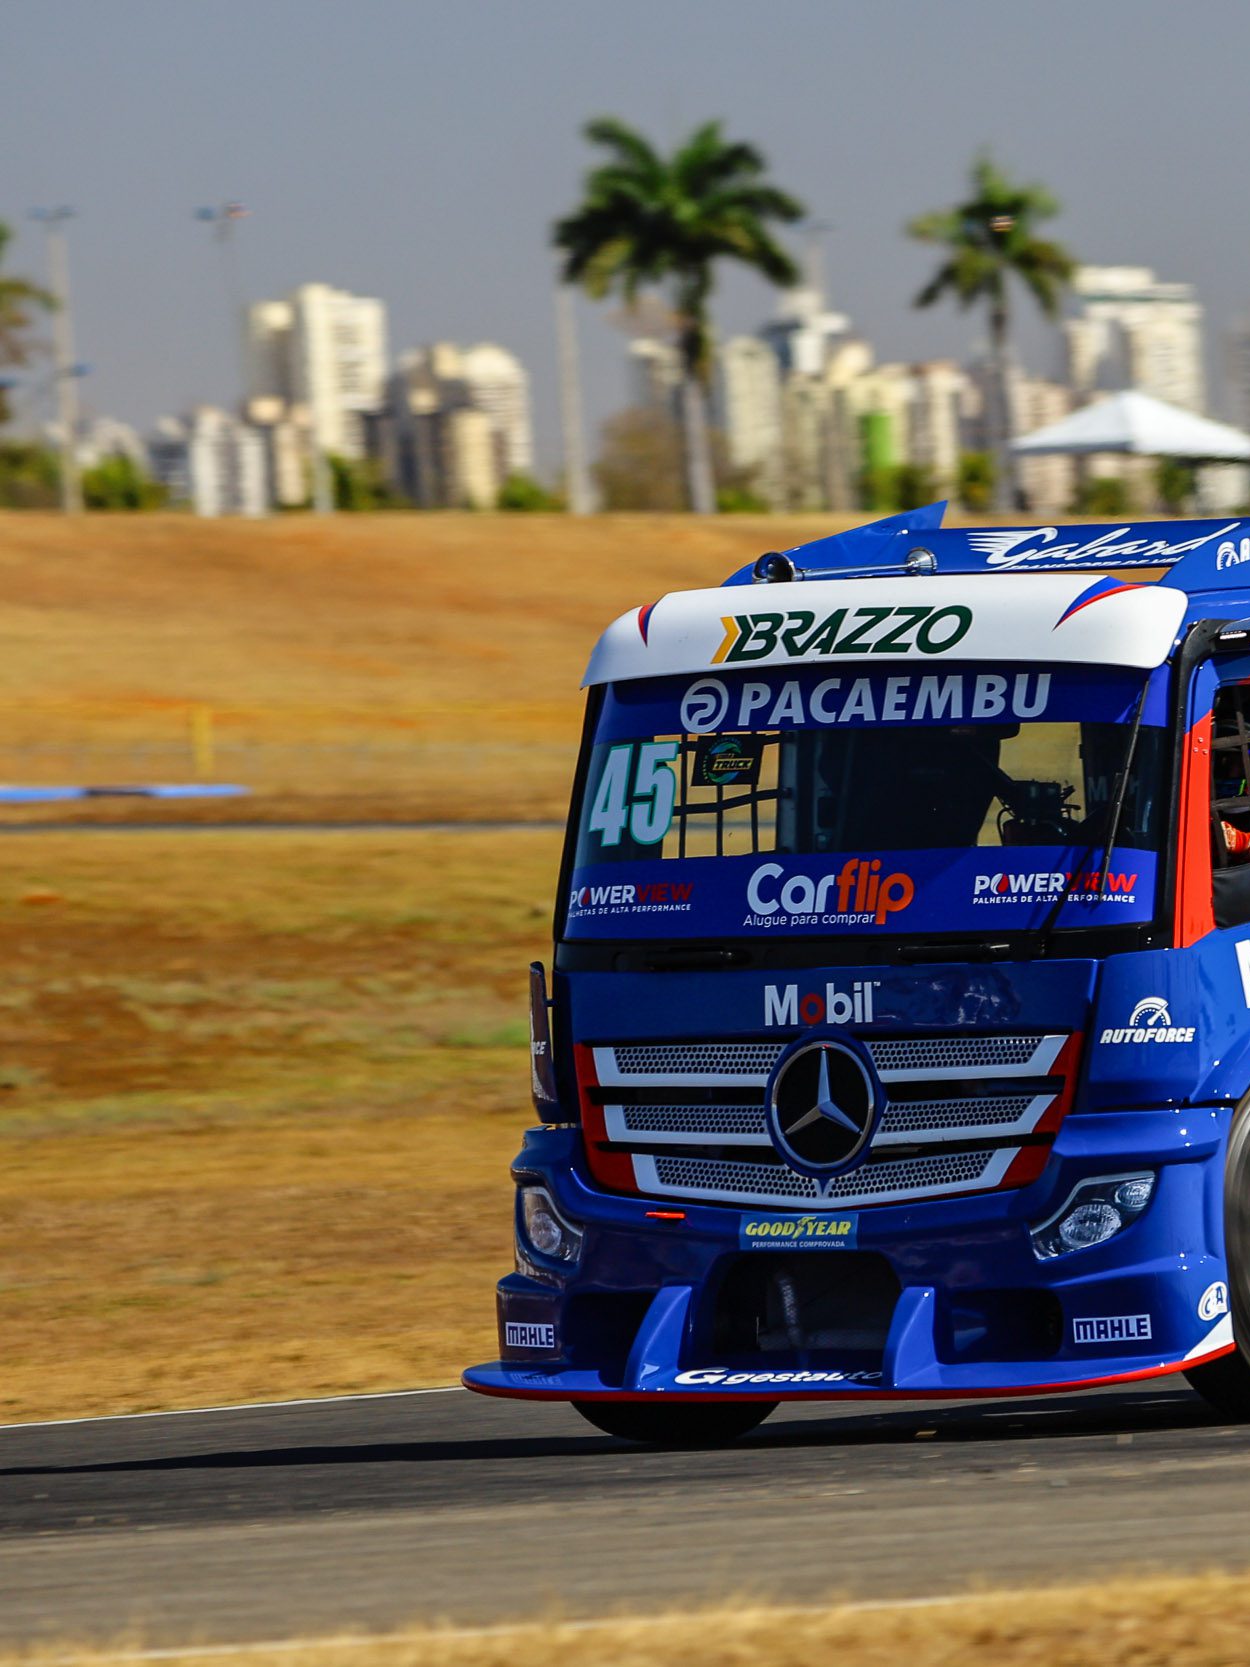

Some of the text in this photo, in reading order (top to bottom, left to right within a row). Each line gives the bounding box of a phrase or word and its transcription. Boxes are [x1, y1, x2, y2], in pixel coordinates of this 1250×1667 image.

[967, 522, 1241, 571] Gabard
[724, 604, 974, 662] BRAZZO
[737, 672, 1052, 725] PACAEMBU
[588, 741, 680, 847] 45
[747, 858, 915, 926] Carflip
[972, 896, 1018, 905] PALHETAS
[1020, 895, 1033, 903] DE
[1064, 894, 1136, 904] ERFORMANCE
[598, 907, 608, 915] DE
[610, 906, 630, 914] ALTA
[632, 904, 691, 913] PERFORMANCE
[743, 913, 876, 929] Alugue para comprar
[1099, 1027, 1196, 1044] AUTOFORCE
[745, 1216, 852, 1239] GOODYEAR
[799, 1240, 846, 1248] COMPROVADA
[507, 1323, 554, 1347] MAHLE
[1075, 1316, 1150, 1341] MAHLE
